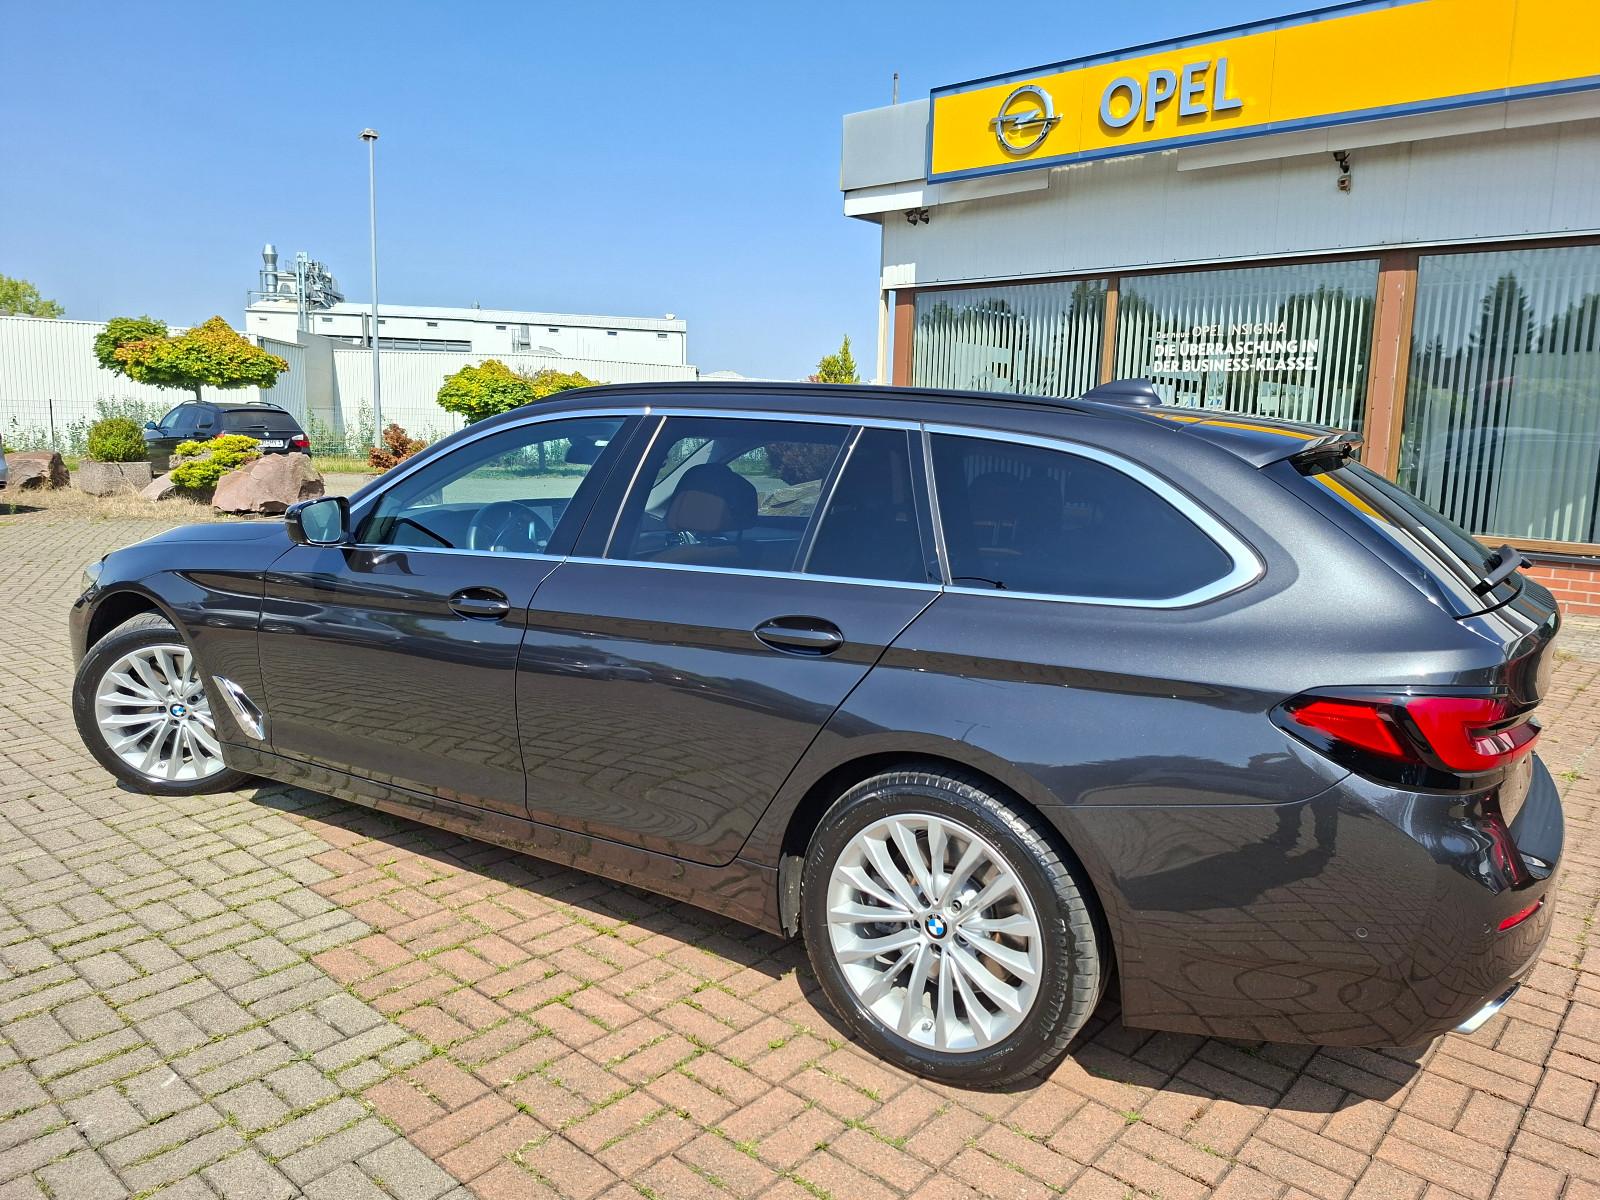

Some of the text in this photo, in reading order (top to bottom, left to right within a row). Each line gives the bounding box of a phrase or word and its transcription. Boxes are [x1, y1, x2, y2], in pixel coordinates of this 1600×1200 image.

[1100, 57, 1243, 128] OPEL
[1156, 331, 1169, 339] Der
[1192, 324, 1224, 337] OPEL
[1155, 339, 1319, 357] DIE ÜBERRASCHUNG IN
[1153, 356, 1318, 373] DER BUSINESS-KLASSE.
